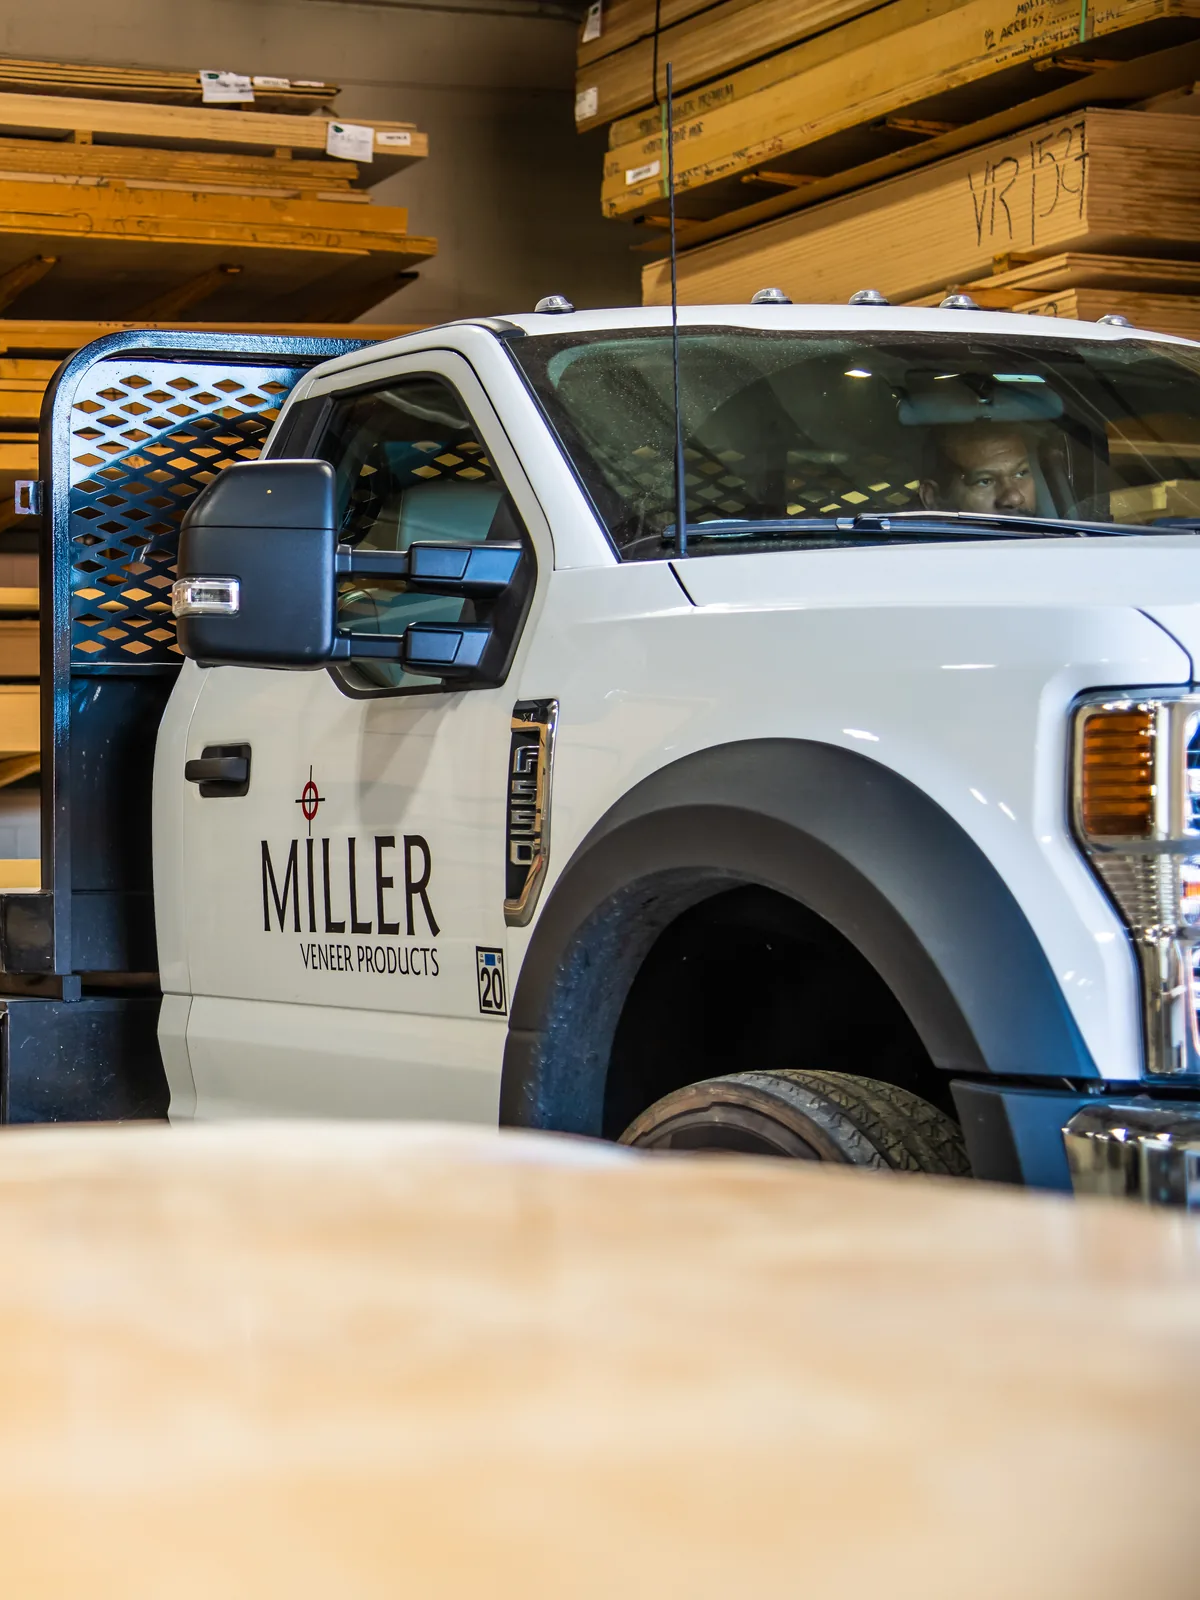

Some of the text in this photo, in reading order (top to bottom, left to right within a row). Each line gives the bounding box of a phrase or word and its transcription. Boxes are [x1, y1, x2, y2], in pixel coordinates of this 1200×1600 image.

[967, 156, 1020, 247] VR
[261, 834, 441, 937] MILLER
[300, 943, 439, 977] VENEER PRODUCTS
[480, 966, 504, 1010] 20
